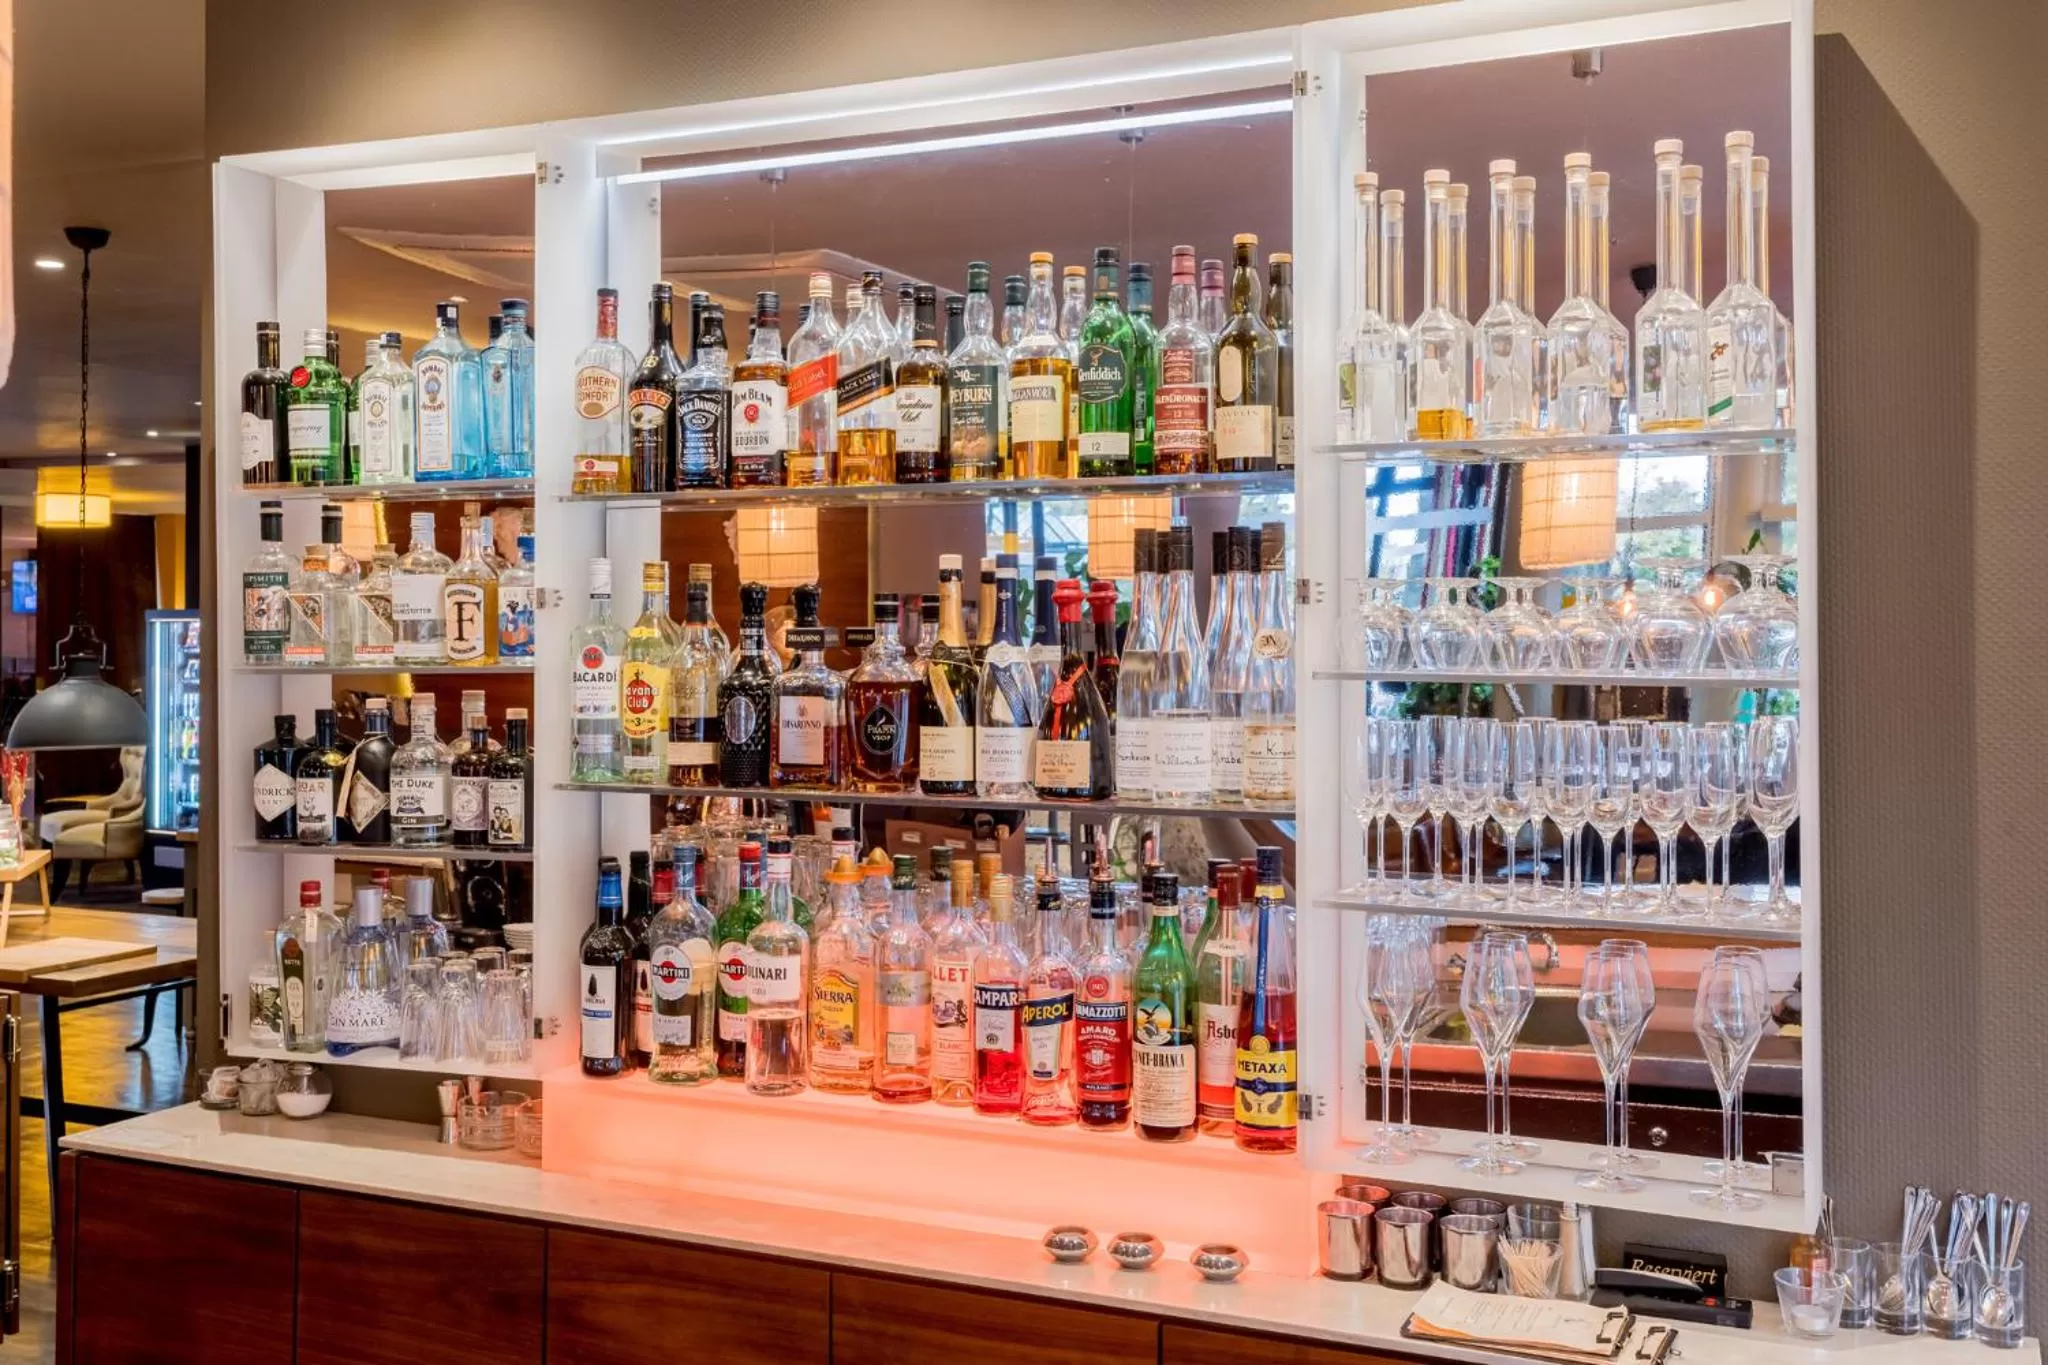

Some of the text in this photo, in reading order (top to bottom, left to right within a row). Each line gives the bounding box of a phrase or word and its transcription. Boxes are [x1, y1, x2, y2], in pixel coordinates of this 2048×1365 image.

[733, 388, 773, 410] JIM BEAM
[735, 436, 769, 446] BOURBON
[1092, 441, 1101, 452] 12
[453, 601, 481, 641] F
[627, 697, 648, 709] Club
[634, 717, 642, 727] 3
[406, 778, 434, 788] DUKE
[815, 985, 854, 1004] SIERRA
[1022, 1003, 1069, 1023] APEROL
[349, 1016, 386, 1027] MARE
[1080, 1027, 1117, 1037] AMARO
[1237, 1060, 1287, 1074] METAXA
[1631, 1258, 1719, 1285] Reserviert
